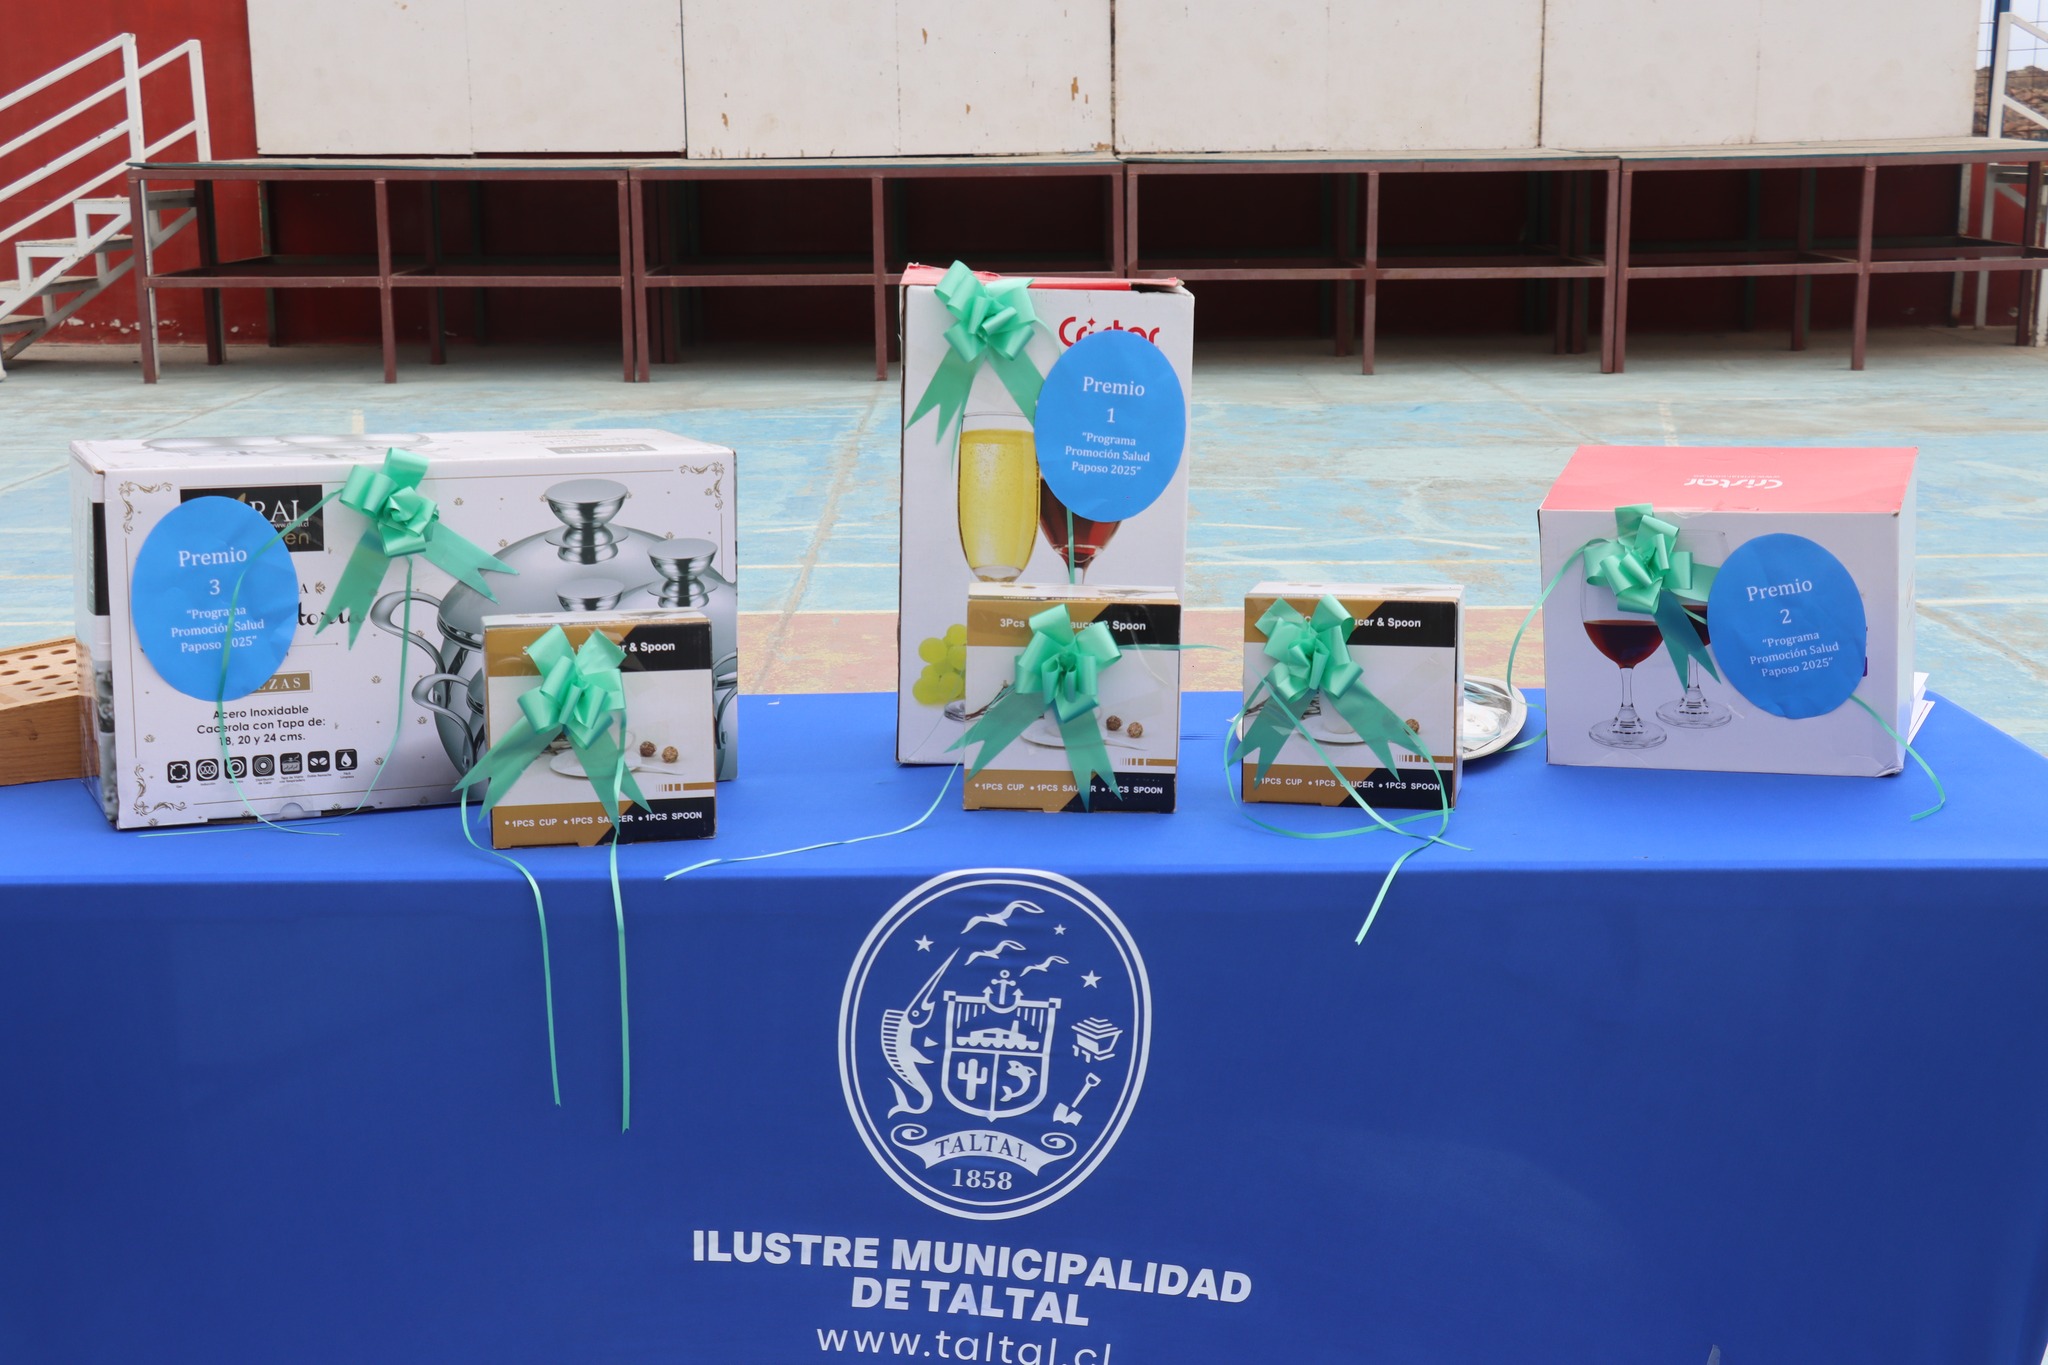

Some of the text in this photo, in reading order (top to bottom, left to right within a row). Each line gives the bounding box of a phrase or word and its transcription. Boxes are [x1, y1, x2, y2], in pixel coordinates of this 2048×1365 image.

[1083, 376, 1145, 396] Premio
[1106, 407, 1115, 423] 1
[1065, 445, 1150, 462] Promoción Salud
[1071, 461, 1108, 474] Paposo
[178, 547, 247, 567] Premio
[209, 579, 220, 595] 3
[1746, 578, 1813, 601] Premio
[1377, 617, 1385, 627] &
[1387, 617, 1421, 629] Spoon
[1780, 608, 1792, 624] 2
[234, 618, 265, 631] Salud
[1000, 618, 1025, 628] 3Pcs
[1112, 620, 1146, 632] Spoon
[181, 635, 257, 654] Paposo 025”
[629, 643, 638, 653] &
[640, 642, 676, 654] Spoon
[1750, 641, 1839, 665] Promoción Salud
[1761, 665, 1800, 677] Paposo
[213, 705, 309, 719] Acero Inoxidable
[197, 717, 326, 734] Cacerola con Tapa de:
[238, 735, 251, 745] 20
[254, 736, 261, 746] y
[264, 733, 276, 743] 24
[280, 733, 305, 742] cms.
[981, 783, 1163, 794] 1PCS CUP 1PCS SAUR 1CS SPOON
[1261, 777, 1441, 791] 1PCS CUP 1PCS SUCER 1PCS SPOON
[512, 811, 703, 828] 1PCS CUP 1PCS SACER 1PCS SPOON
[935, 1133, 1028, 1162] TALTAL
[951, 1168, 1013, 1190] 1858
[693, 1230, 1252, 1304] ILUSTRE MUNICIPALIDAD
[851, 1276, 1090, 1327] DE TALTAL
